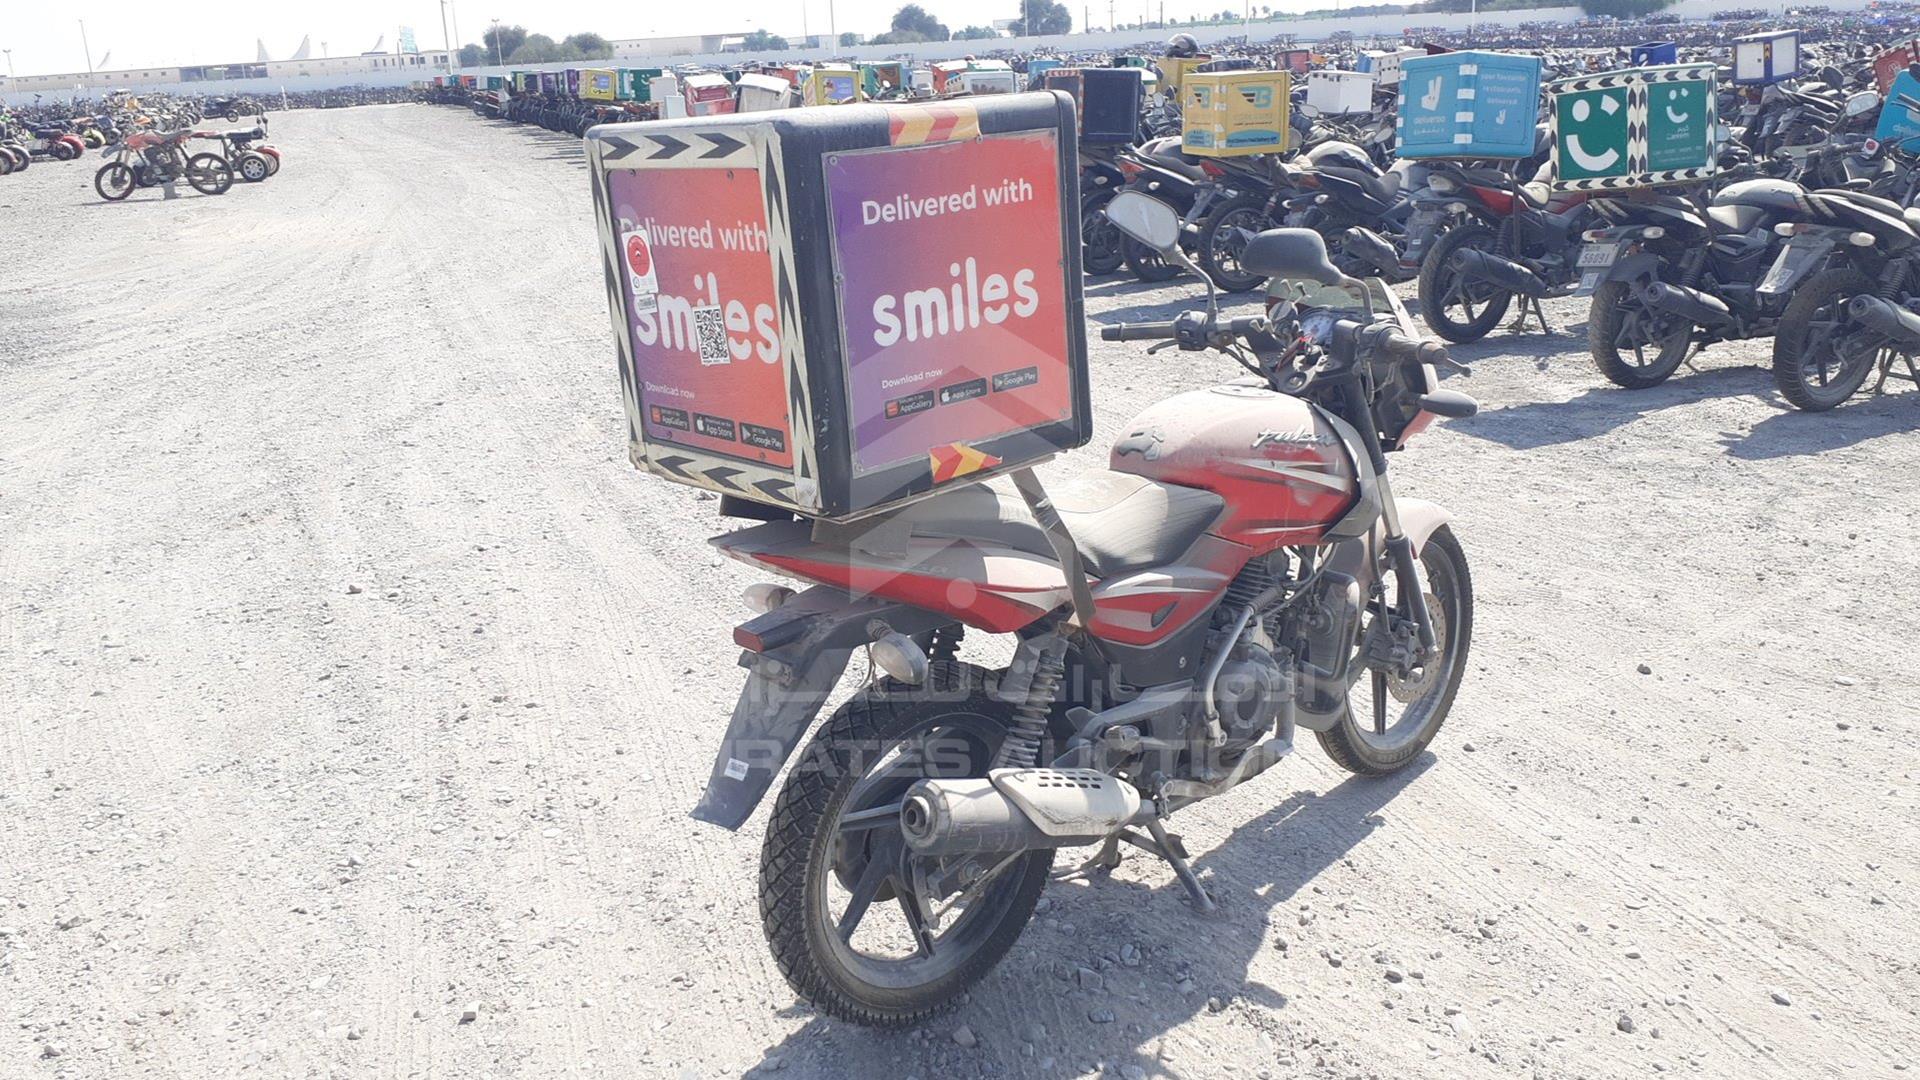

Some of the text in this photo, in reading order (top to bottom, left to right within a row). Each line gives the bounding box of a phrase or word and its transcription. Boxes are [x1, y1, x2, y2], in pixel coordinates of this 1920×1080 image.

[862, 178, 1033, 225] Delivered with
[620, 217, 768, 251] Dlivered with
[873, 256, 1039, 347] smiles
[645, 381, 695, 400] Download now
[882, 368, 943, 389] Download now
